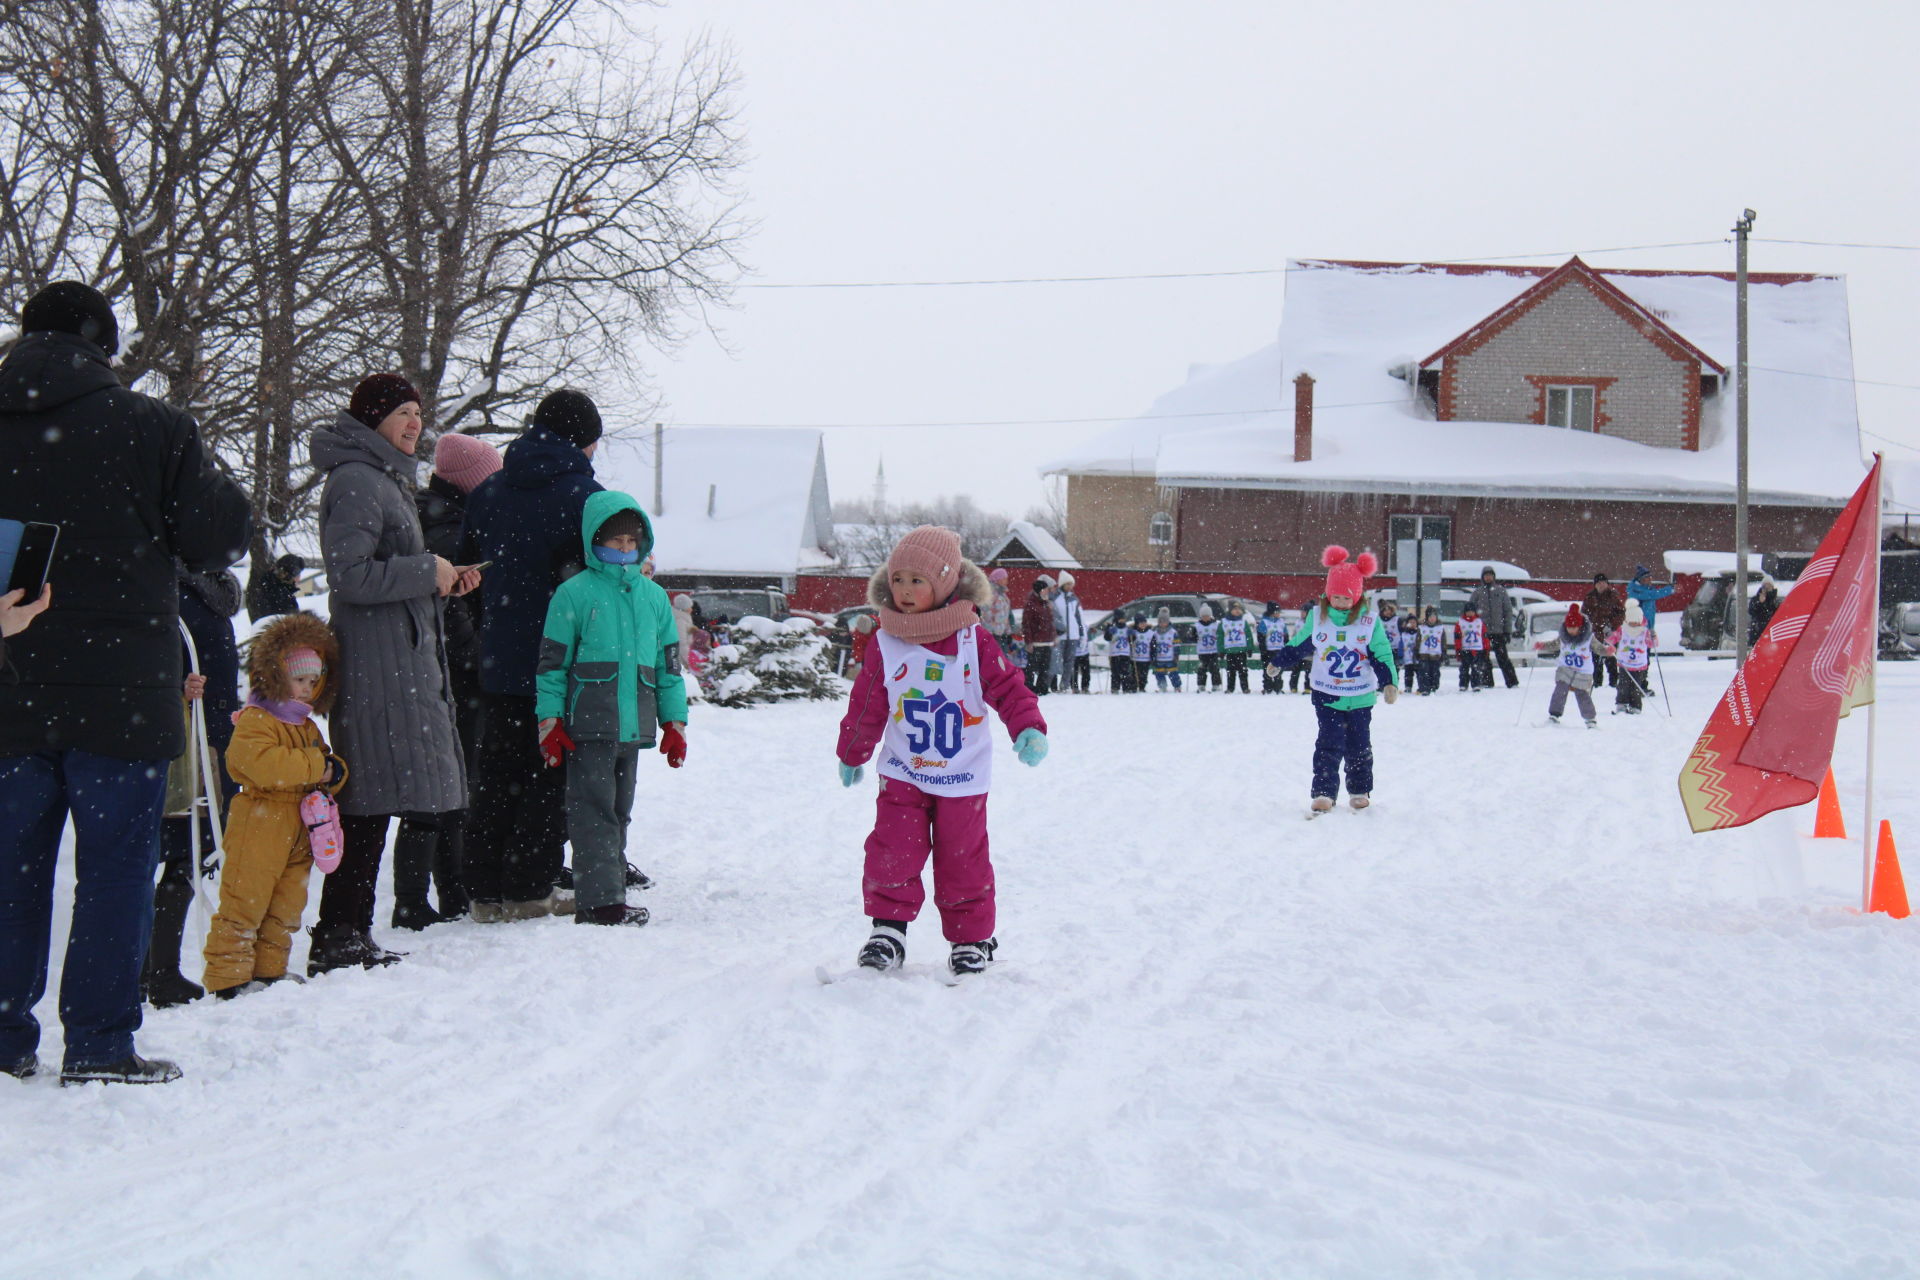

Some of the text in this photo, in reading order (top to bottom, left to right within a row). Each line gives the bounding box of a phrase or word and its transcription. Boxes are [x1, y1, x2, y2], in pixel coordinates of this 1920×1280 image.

[1228, 631, 1241, 641] 12
[1465, 632, 1478, 643] 21
[1116, 638, 1127, 649] 28
[1424, 637, 1438, 648] 49
[1629, 648, 1636, 660] 3
[1326, 651, 1361, 678] 22
[1564, 655, 1584, 668] 60
[903, 699, 963, 759] 50
